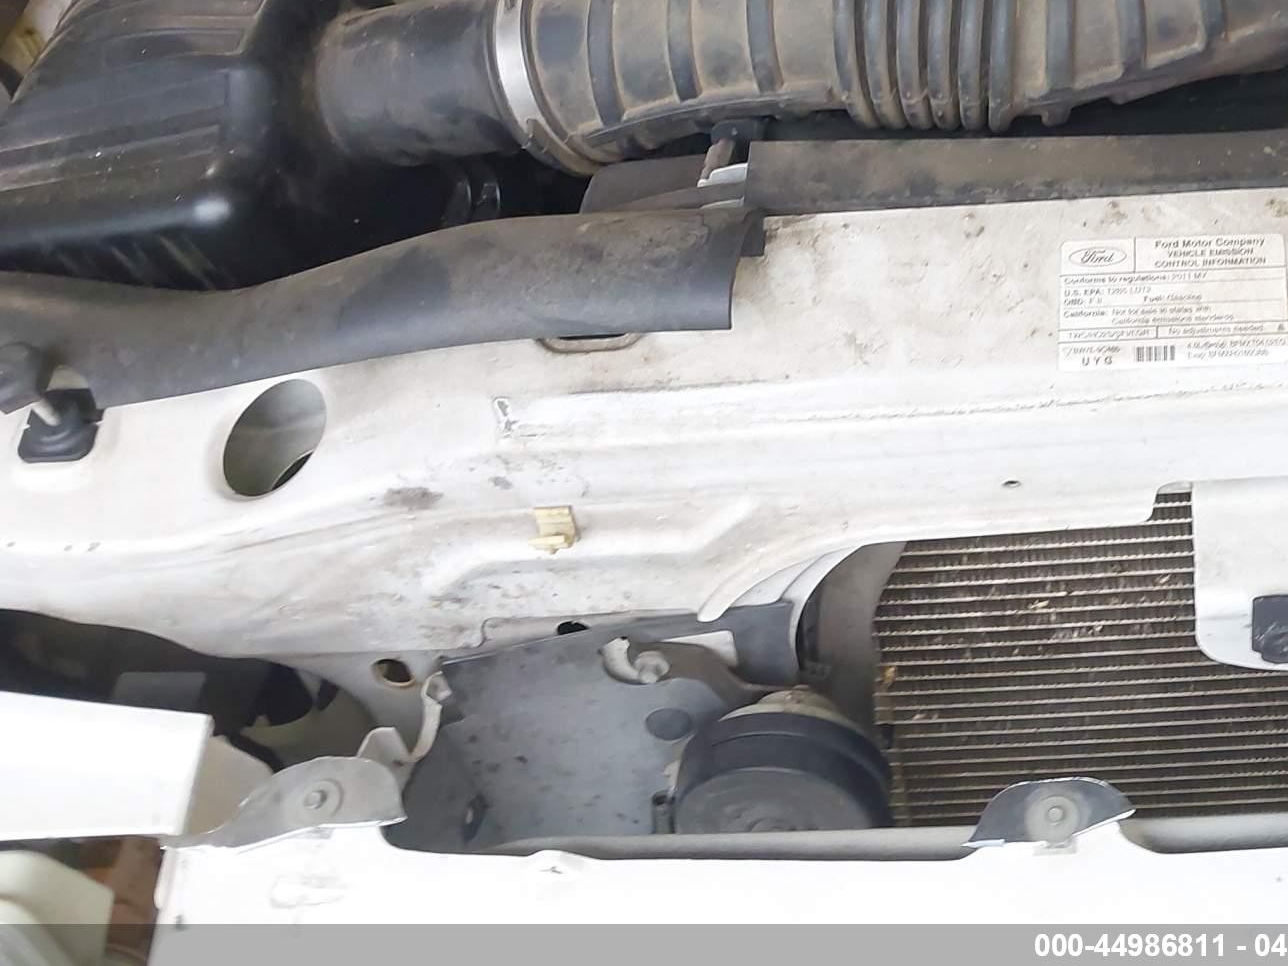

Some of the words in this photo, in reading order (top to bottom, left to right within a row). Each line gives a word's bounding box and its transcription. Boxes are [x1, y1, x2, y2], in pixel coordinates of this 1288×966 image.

[1155, 240, 1180, 249] Ford
[1183, 239, 1212, 248] Motor
[1215, 237, 1265, 248] Company
[1168, 249, 1206, 258] VEHICLE
[1209, 247, 1254, 257] EMISSION
[1154, 259, 1199, 269] CONTROL
[1202, 256, 1266, 267] INFORMATION
